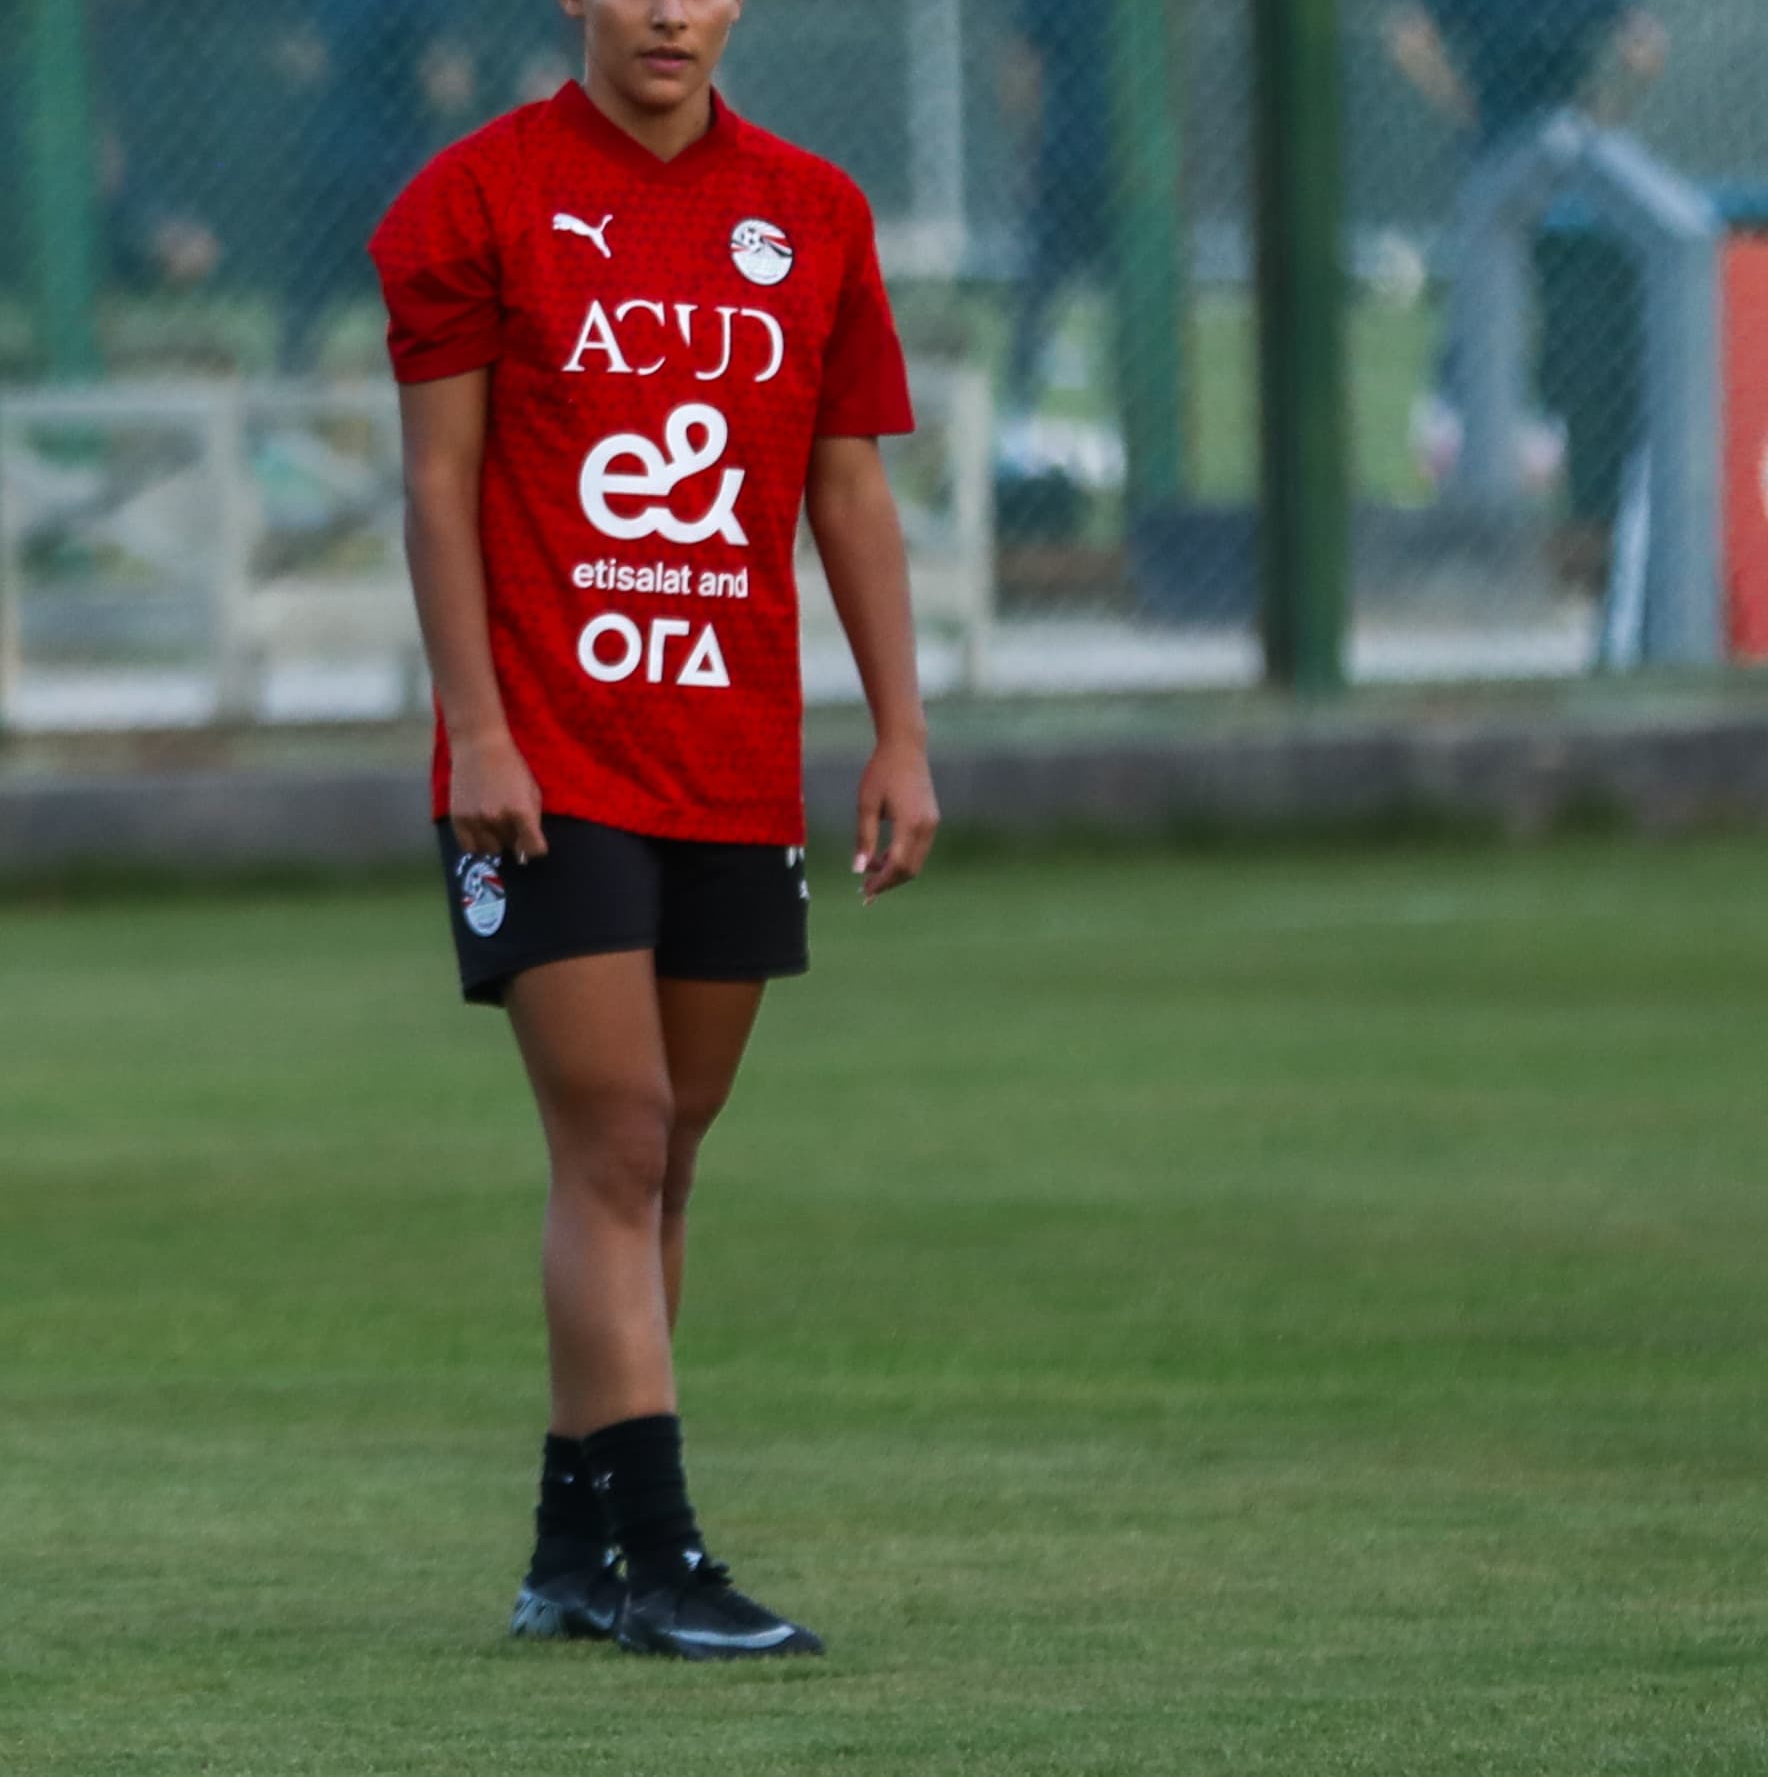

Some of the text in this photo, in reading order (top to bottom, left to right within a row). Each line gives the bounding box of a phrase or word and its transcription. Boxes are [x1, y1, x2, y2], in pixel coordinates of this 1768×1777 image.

[561, 299, 785, 383] ACUD
[573, 559, 749, 599] etisalat and
